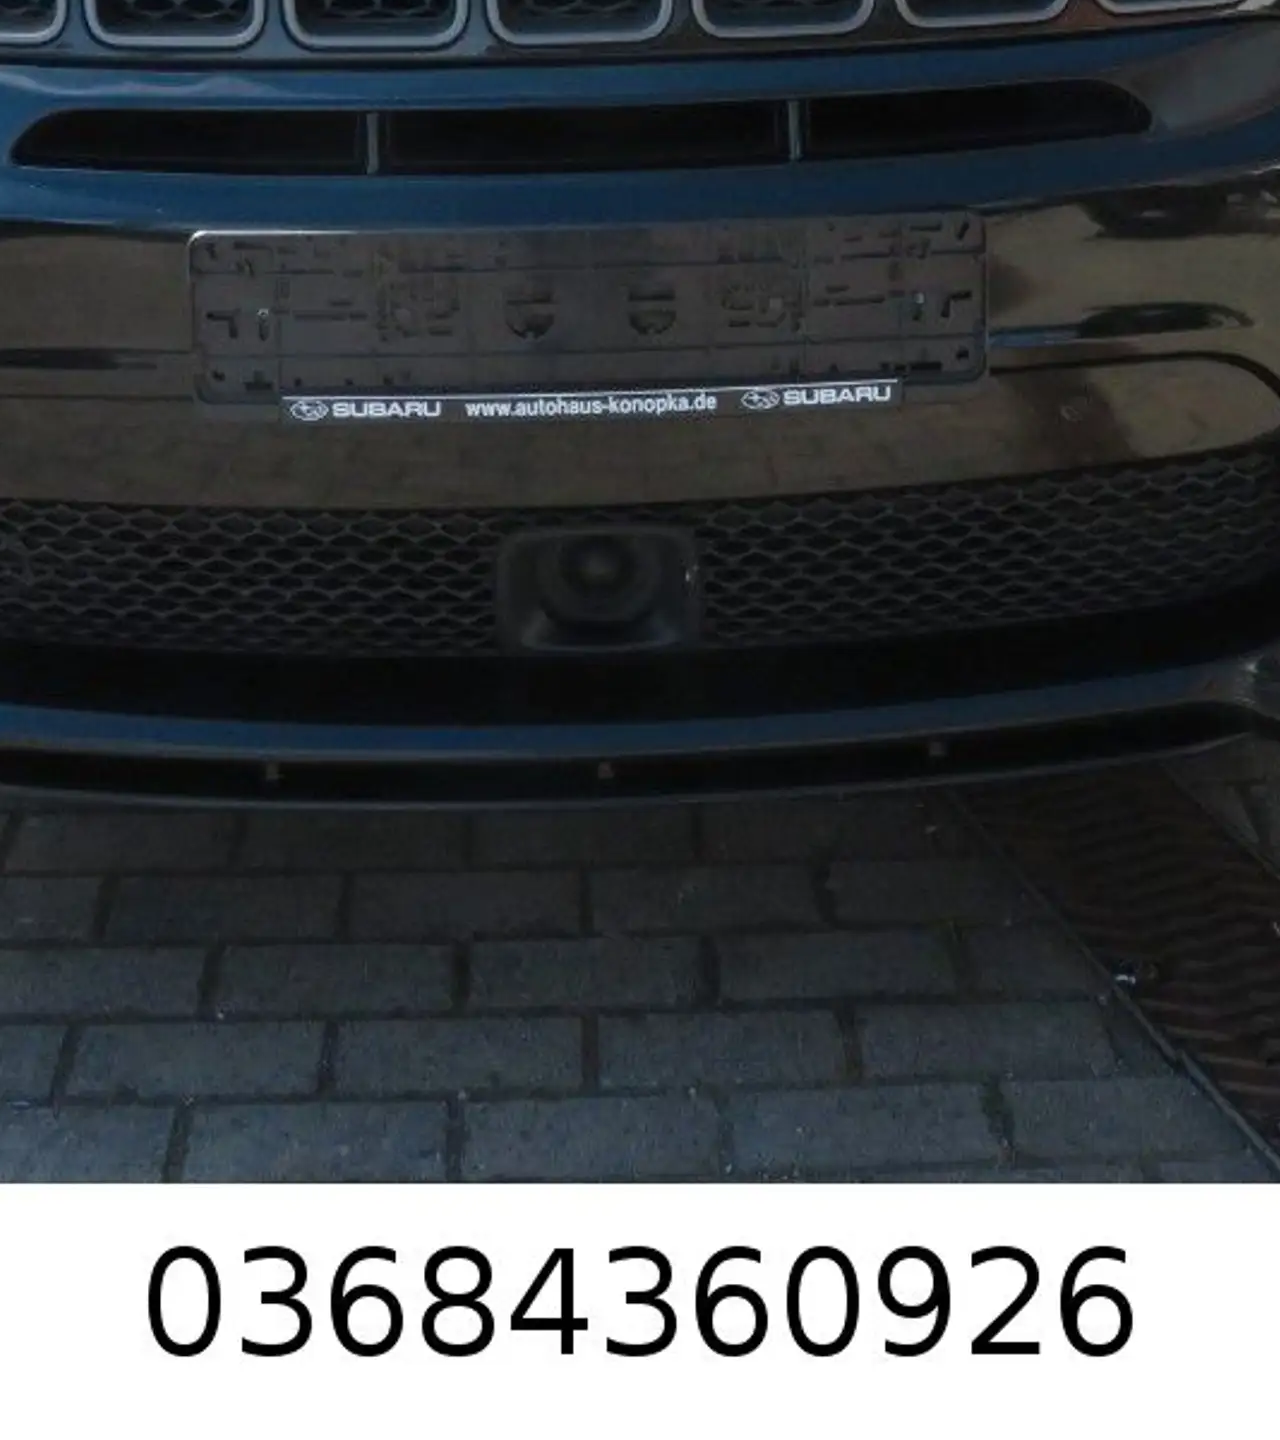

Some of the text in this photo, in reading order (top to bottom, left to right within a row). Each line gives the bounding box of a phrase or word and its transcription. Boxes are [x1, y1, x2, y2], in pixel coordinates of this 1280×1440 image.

[332, 385, 891, 418] SUBARU www.autohaus-konopka.de SUBARU
